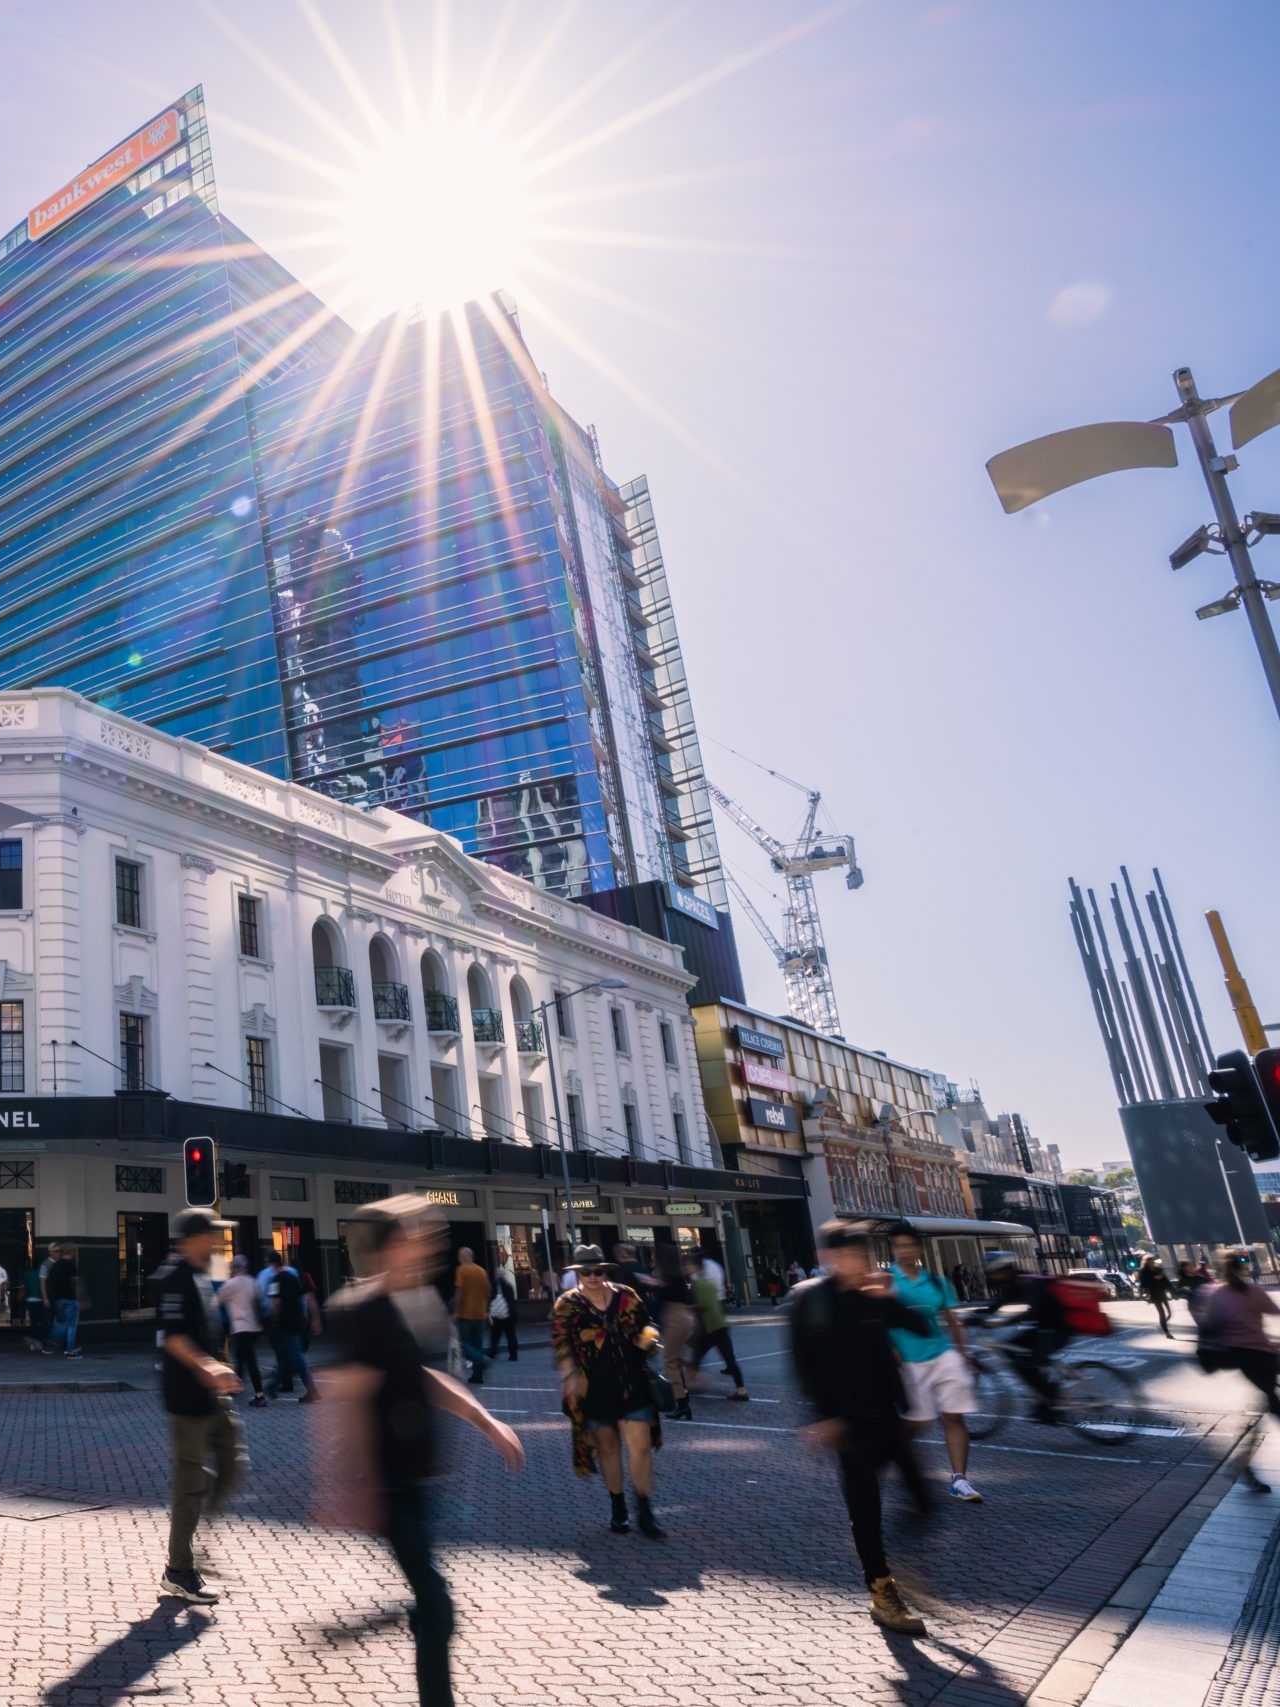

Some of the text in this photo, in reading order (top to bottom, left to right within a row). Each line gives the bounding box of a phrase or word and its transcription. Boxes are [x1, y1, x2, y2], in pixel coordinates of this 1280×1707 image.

[34, 146, 134, 229] bankwest
[385, 887, 412, 906] HOTEL
[741, 1032, 783, 1053] PALACE CINEMAS
[748, 1064, 774, 1085] coles
[765, 1106, 786, 1127] rebel
[735, 1178, 760, 1189] KAILIS
[426, 1191, 460, 1205] CHANEL
